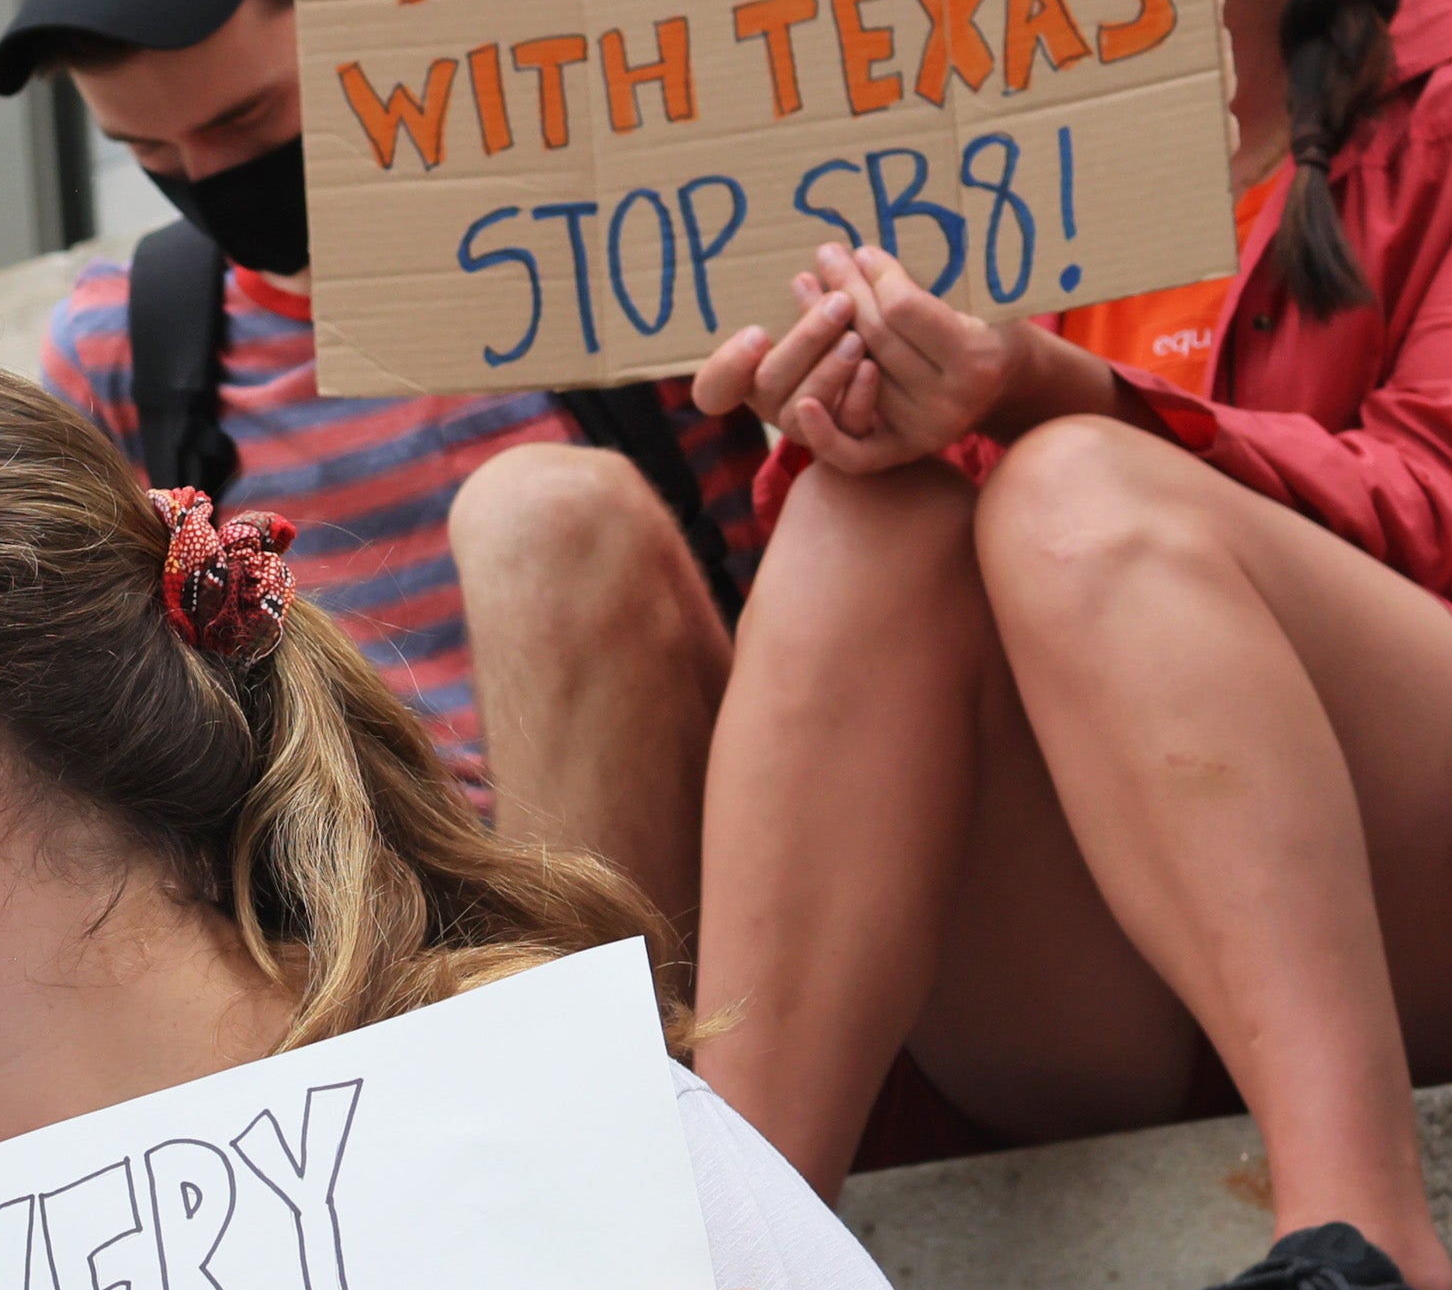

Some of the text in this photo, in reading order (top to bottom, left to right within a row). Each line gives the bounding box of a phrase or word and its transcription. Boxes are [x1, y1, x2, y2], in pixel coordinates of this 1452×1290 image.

[337, 15, 697, 171] WITH
[457, 126, 1083, 369] STOP SB8!
